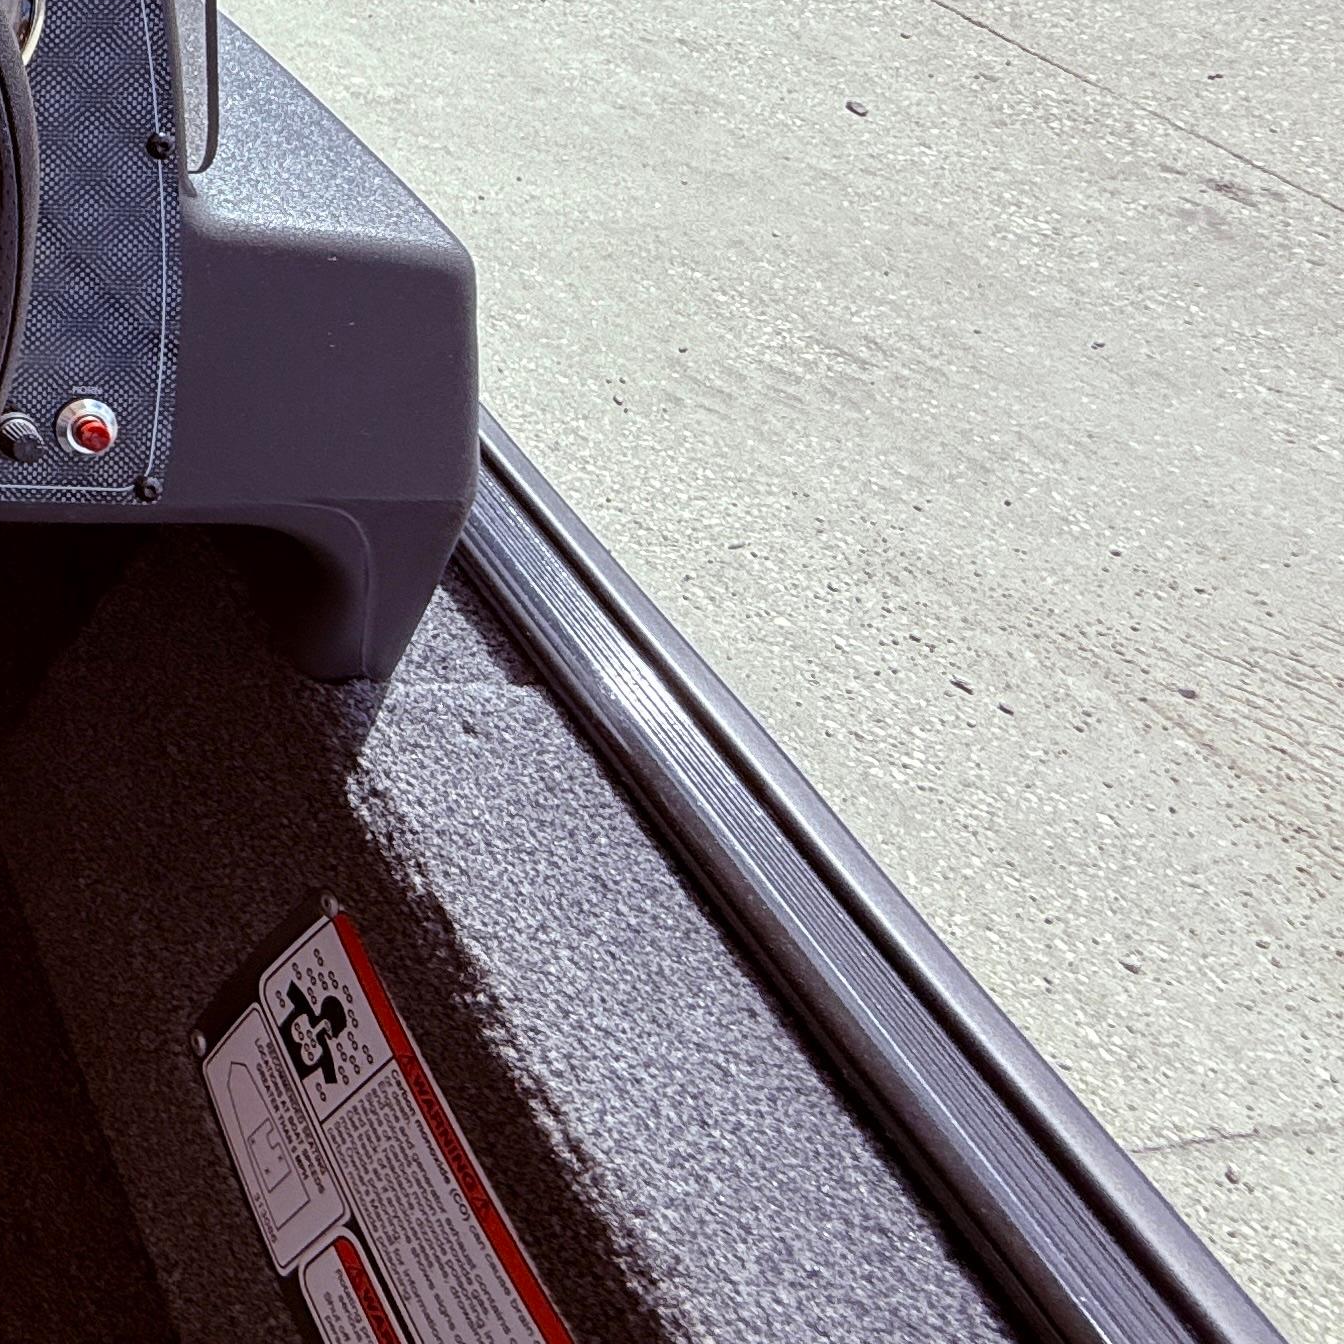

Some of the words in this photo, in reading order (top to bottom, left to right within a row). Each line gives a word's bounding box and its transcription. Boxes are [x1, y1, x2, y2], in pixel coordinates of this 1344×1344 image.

[313, 948, 324, 967] CO
[292, 962, 302, 981] CO
[306, 967, 317, 986] CO
[317, 972, 329, 991] CO
[328, 970, 339, 990] CO
[275, 990, 286, 1009] CO
[307, 986, 317, 1005] CO
[342, 985, 353, 1003] CO
[347, 1009, 359, 1029] CO
[294, 1022, 304, 1041] CO
[306, 1029, 317, 1049] CO
[347, 1031, 358, 1051] CO
[303, 1042, 314, 1062] CO
[336, 1042, 348, 1063] CO
[362, 1044, 374, 1065] CO
[349, 1054, 361, 1075] CO
[338, 1065, 349, 1085] CO
[315, 1082, 326, 1102] CO
[254, 1037, 283, 1098] LOCATIONS
[279, 1099, 290, 1113] AT
[287, 1114, 304, 1145] BOAT
[301, 1147, 325, 1194] SPEEDS
[255, 1062, 280, 1113] GREATER
[277, 1113, 293, 1144] THAN
[294, 1154, 309, 1180] MPH
[410, 1072, 478, 1195] WARNING
[370, 1087, 386, 1111] and
[411, 1170, 436, 1216] carbon
[435, 1218, 473, 1285] monoxide
[376, 1080, 400, 1123] Engine
[398, 1125, 415, 1150] and
[410, 1152, 447, 1213] generator
[444, 1217, 476, 1270] exhaust
[474, 1273, 511, 1335] contains
[390, 1068, 416, 1116] Carbon
[414, 1119, 451, 1184] monoxide
[448, 1187, 471, 1222] (CO)
[468, 1224, 486, 1250] can
[484, 1252, 511, 1296] cause
[509, 1297, 534, 1337] brain
[388, 1143, 413, 1188] carbon
[411, 1190, 447, 1256] monoxide
[444, 1258, 485, 1329] poisoning
[449, 1285, 484, 1344] drowsin
